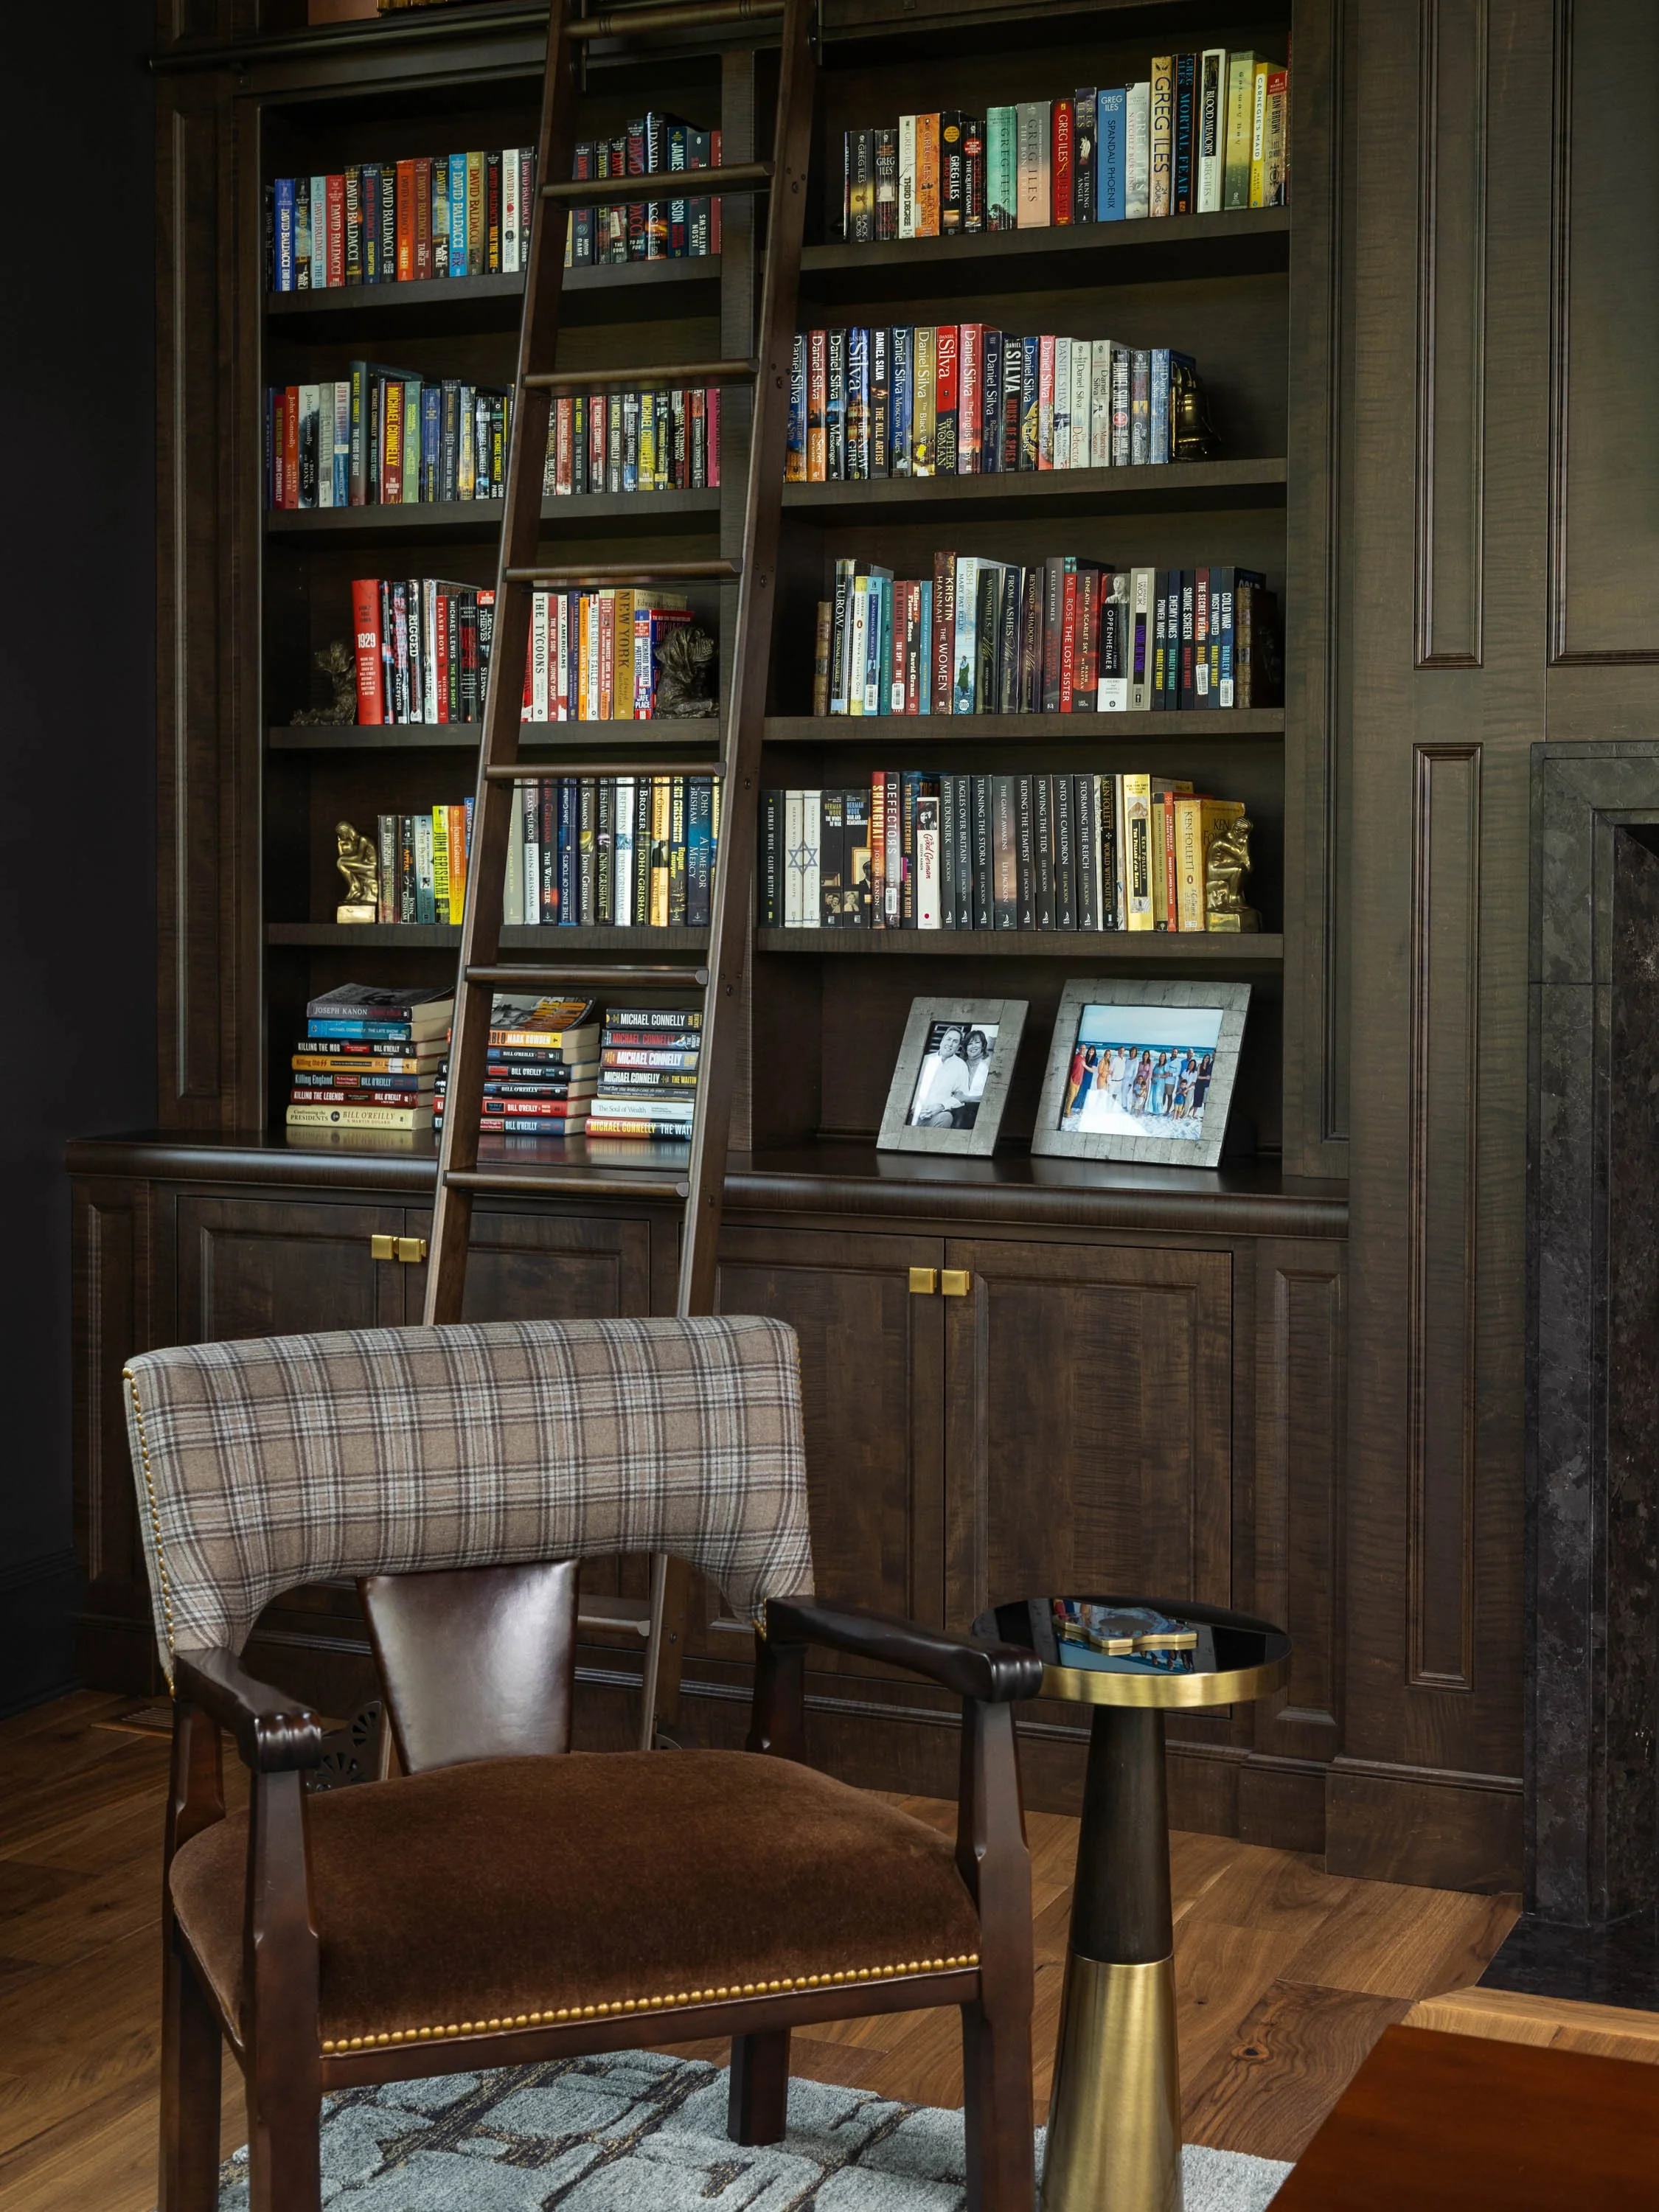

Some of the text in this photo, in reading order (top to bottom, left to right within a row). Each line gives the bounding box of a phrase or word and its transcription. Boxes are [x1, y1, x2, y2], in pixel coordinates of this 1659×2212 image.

[1101, 95, 1122, 105] GREG
[1105, 104, 1119, 112] ILES
[1272, 95, 1281, 135] DAN BROWN
[1154, 76, 1171, 173] GREG ILES
[1178, 93, 1189, 194] MORTAL FEAR
[858, 143, 866, 184] GREG ILES
[950, 156, 959, 204] GREG ILES
[1027, 118, 1037, 203] GREG ILES
[1107, 119, 1116, 209] SPANDAU PHOENIX
[383, 178, 394, 257] DAVID BALDACCI
[904, 177, 912, 226] THIRD DEGREE
[330, 204, 341, 274] DAVID BALDACCI
[418, 243, 426, 266] TARGET
[698, 213, 708, 256] MATTHEWS
[452, 251, 460, 267] FIX
[812, 335, 823, 400] Daniel Silva
[937, 338, 956, 380] Silva
[1005, 350, 1023, 394] SILVA
[875, 332, 885, 466] DANIEL SILVA THE KILL ARTIST
[894, 330, 906, 455] Daniel Silva Moscow Rules
[986, 353, 998, 416] Daniel Silva
[386, 387, 399, 467] MICHAEL CONNELLY
[936, 421, 947, 467] WOMAN
[945, 417, 956, 470] the OTHER
[1005, 398, 1018, 464] HOUSE OF SPIES
[494, 457, 502, 481] CONNELLY
[535, 596, 545, 618] THE
[835, 581, 845, 627] TUROW
[945, 577, 954, 622] KRISTIN
[1156, 599, 1166, 640] POWER MOVE
[1168, 595, 1178, 639] ENEMY LINES
[1183, 587, 1192, 640] SMOKE SCREEN
[1197, 581, 1206, 641] THE SECRET WEAPON
[1221, 593, 1232, 630] COLD WAR
[358, 633, 377, 649] 1929
[408, 614, 420, 657] RIGGED
[438, 636, 446, 660] BOYS
[534, 624, 545, 675] TYCOONS
[618, 591, 630, 669] NEW YORK
[1062, 577, 1074, 703] M.L. ROSE THE LOST SISTER
[1105, 610, 1115, 671] OPPENHEIMER
[937, 644, 948, 692] WOMEN
[700, 790, 710, 816] JOHN
[1079, 781, 1089, 826] STORMING
[1102, 779, 1110, 796] KEN
[639, 790, 649, 830] BROKER
[1102, 796, 1111, 831] FOLLETT
[873, 785, 885, 906] SHANGHAI JOSEPH KANON
[1081, 827, 1089, 844] THE
[1183, 810, 1194, 872] KEN FOLLETT
[434, 832, 449, 895] JOHN GRISHAM
[689, 846, 699, 879] MERCY
[698, 836, 709, 888] A TIME FOR
[1082, 845, 1090, 870] REICH
[543, 867, 552, 904] WHISTLER
[562, 877, 568, 887] OF
[637, 849, 647, 922] JOHN GRISHAM
[1104, 866, 1112, 893] WITHOUT
[1104, 894, 1112, 912] END
[314, 1006, 340, 1015] JOSEPH
[342, 1007, 368, 1016] KANON
[620, 1013, 685, 1027] MICHAEL CONNELLY
[297, 1042, 341, 1052] KILLING THE MOB
[374, 1044, 400, 1053] BILL O'REILLY
[295, 1074, 333, 1086] Killing England
[511, 1067, 542, 1077] BILL O'REILLY
[293, 1091, 344, 1102] KILLING THE LEGENDS
